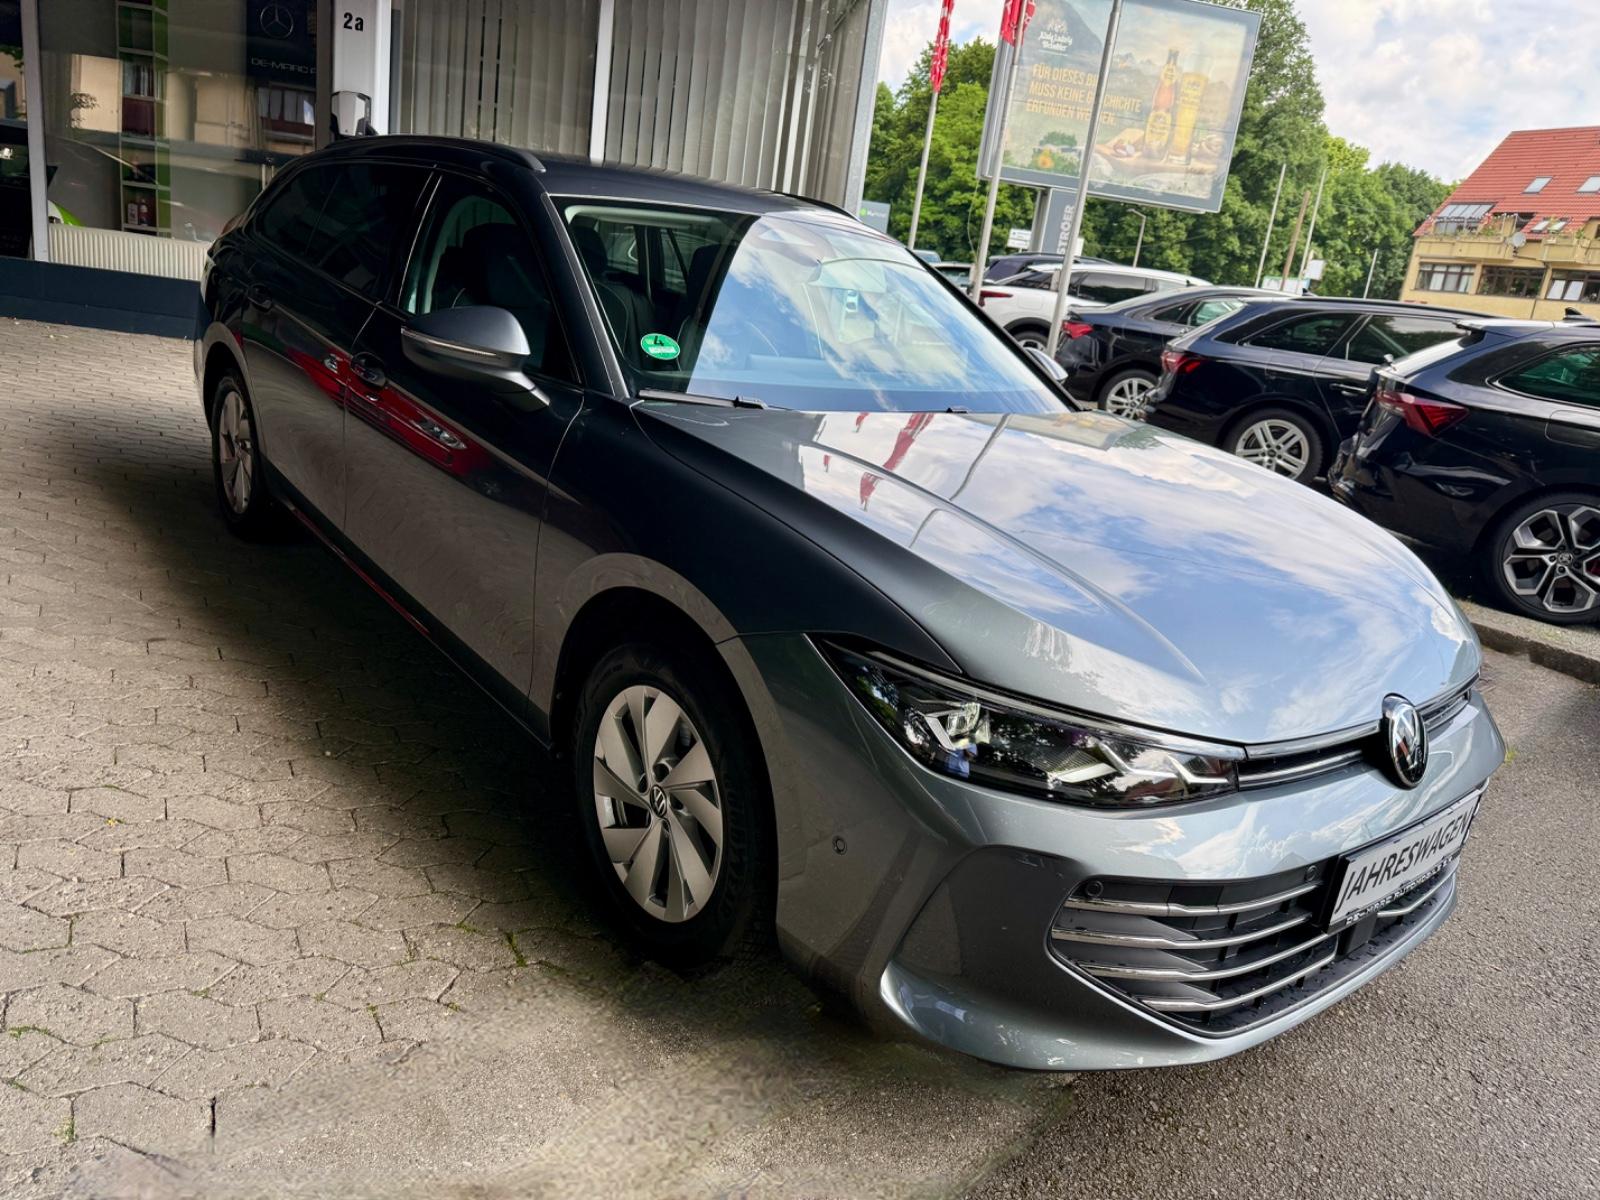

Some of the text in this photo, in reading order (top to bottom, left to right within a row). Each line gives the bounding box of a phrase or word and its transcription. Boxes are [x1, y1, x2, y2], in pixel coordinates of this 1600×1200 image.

[343, 11, 365, 32] 2a
[1029, 81, 1057, 98] MUSS
[1057, 85, 1086, 103] KEINE
[1334, 806, 1474, 914] JAHRESWAGEN
